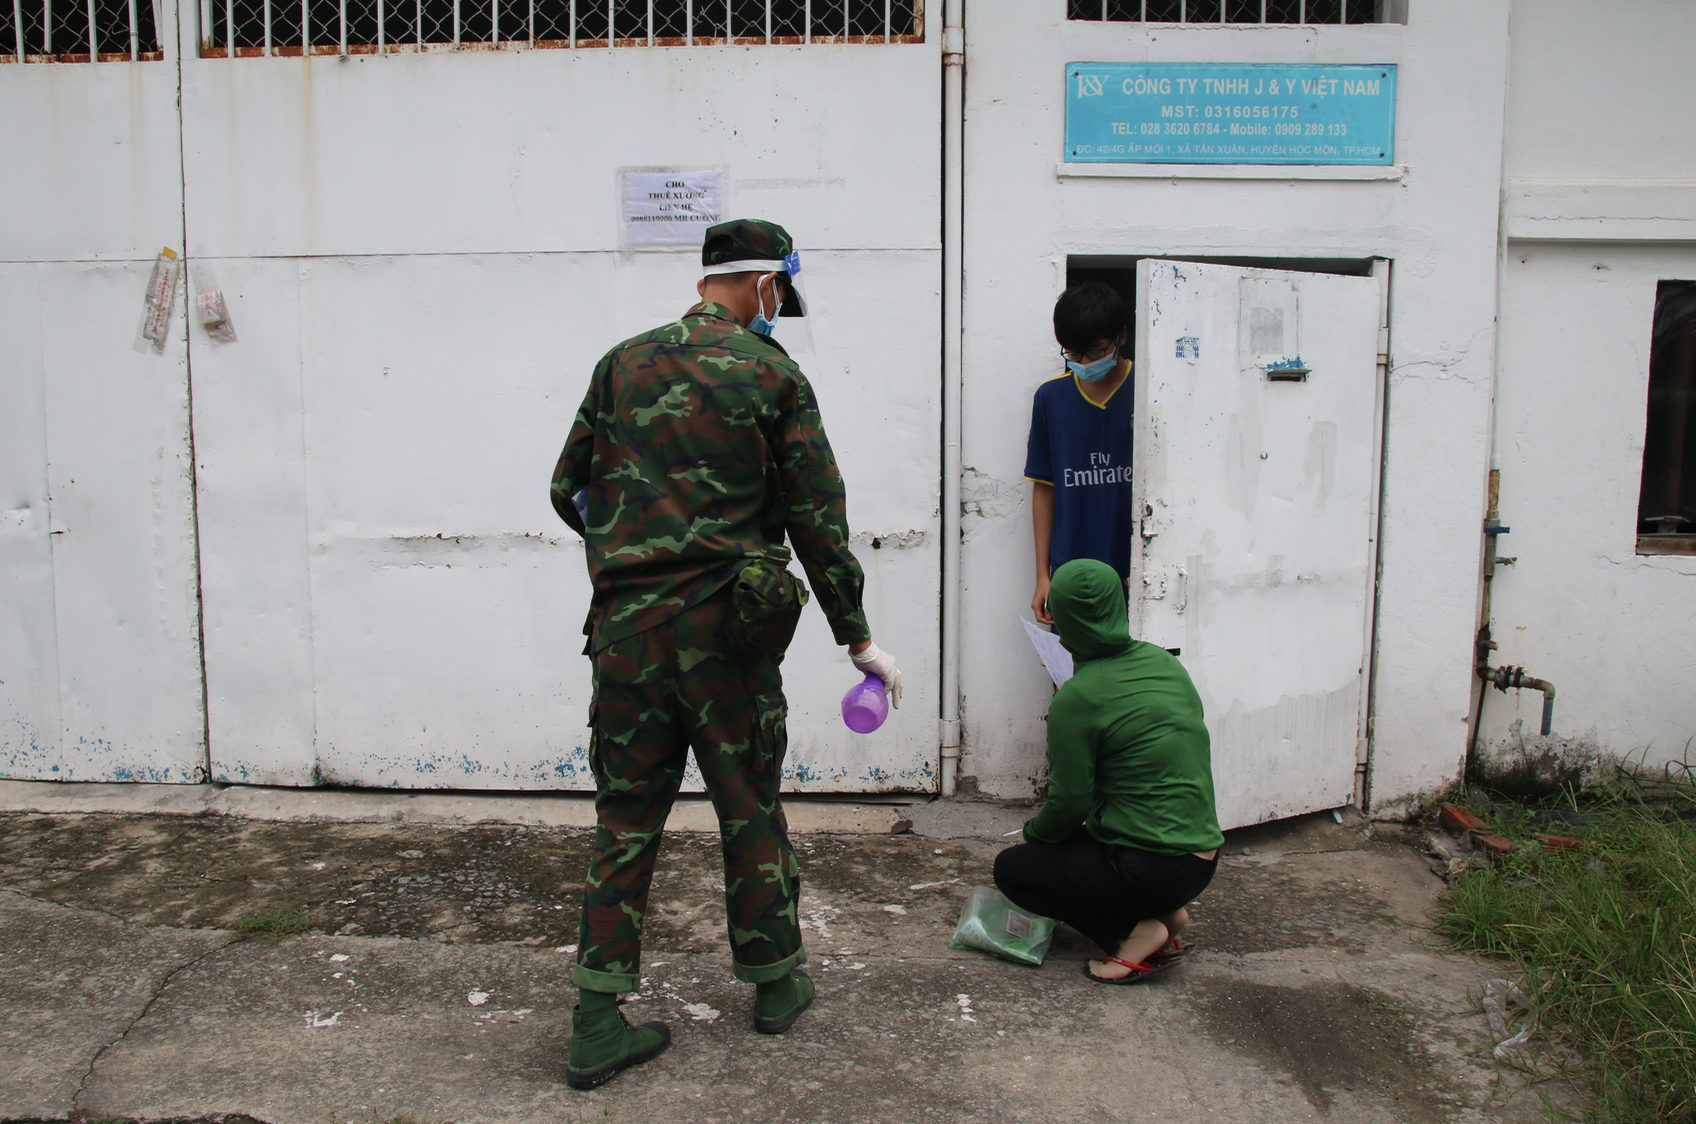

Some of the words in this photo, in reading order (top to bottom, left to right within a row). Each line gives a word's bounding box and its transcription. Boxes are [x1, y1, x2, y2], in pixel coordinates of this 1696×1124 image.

[1122, 74, 1171, 95] CÔNG
[1176, 78, 1198, 95] TY
[1203, 78, 1249, 95] TNHH
[1254, 78, 1263, 95] J
[1268, 78, 1280, 95] &
[1285, 78, 1297, 95] Y
[1301, 75, 1338, 99] VIỆT
[1343, 79, 1380, 96] NAM
[1161, 105, 1199, 118] MST:
[1204, 105, 1299, 118] 0316056175
[1111, 122, 1137, 135] TEL:
[1140, 122, 1161, 135] 028
[1164, 122, 1190, 135] 3620
[1193, 122, 1220, 135] 6784
[1230, 122, 1272, 136] Mobile:
[1275, 123, 1301, 136] 0909
[1304, 123, 1325, 136] 289
[1328, 123, 1348, 136] 133
[1076, 144, 1095, 154] ĐC:
[1097, 144, 1125, 154] 42/4G
[1177, 143, 1191, 154] XÃ
[1194, 143, 1215, 154] TÂN
[1217, 143, 1248, 155] XUÂN,
[1250, 143, 1287, 156] HUYỆN
[1314, 144, 1340, 156] MÔN,
[1343, 145, 1381, 156] TP.HCM
[665, 180, 685, 189] CHO
[648, 190, 671, 200] THUÊ
[674, 214, 688, 222] MR
[1090, 452, 1111, 466] Fly
[1063, 465, 1134, 488] Emirate
